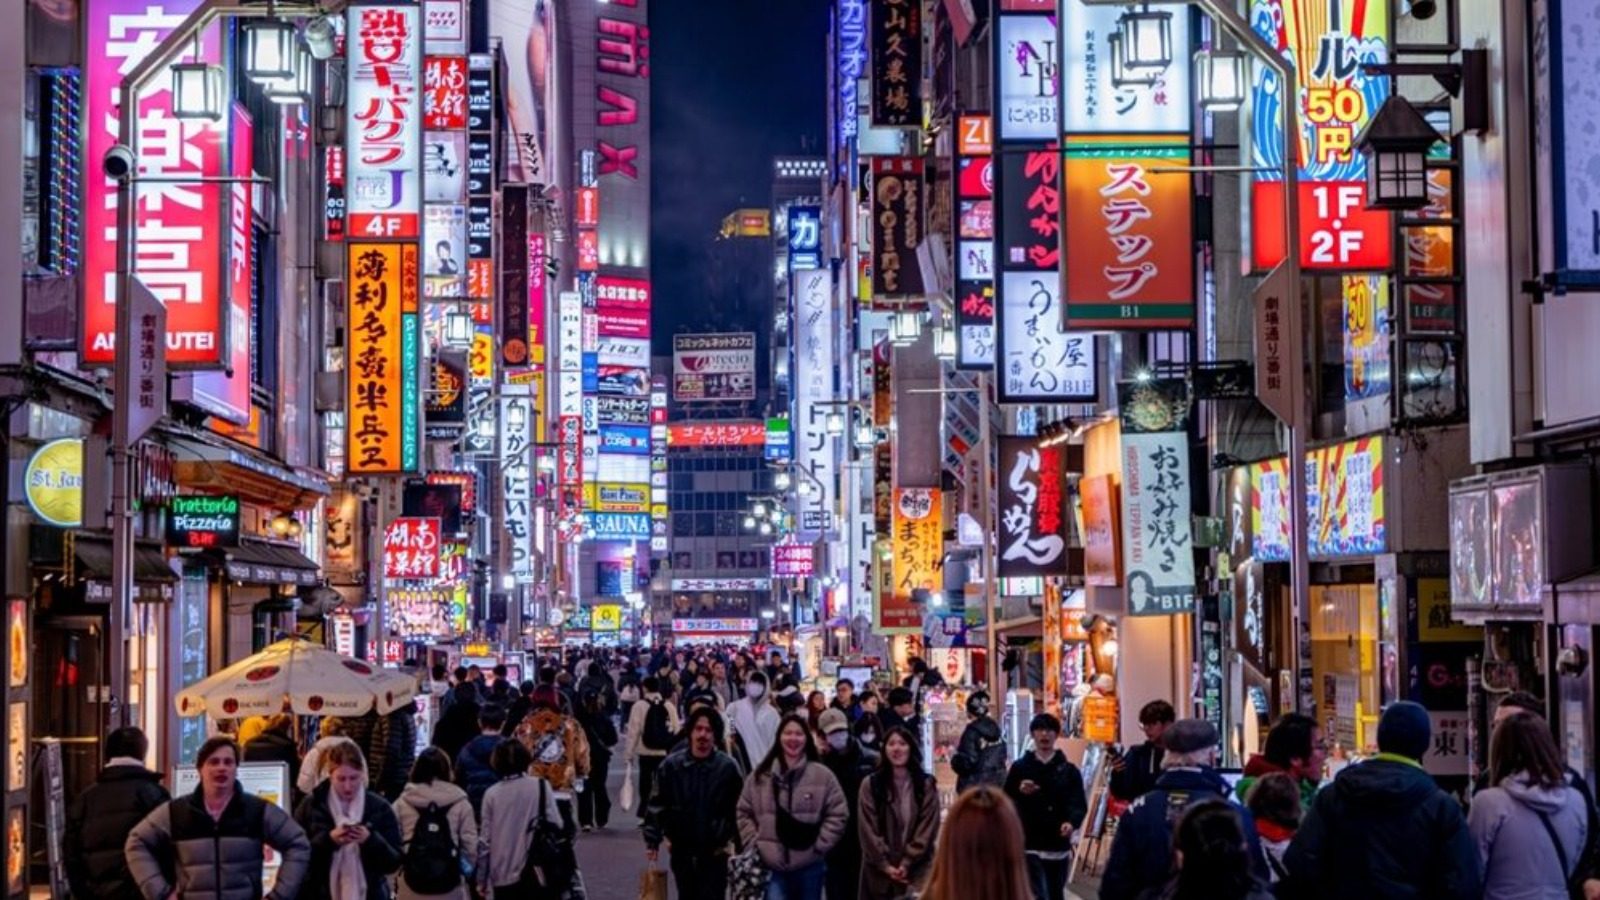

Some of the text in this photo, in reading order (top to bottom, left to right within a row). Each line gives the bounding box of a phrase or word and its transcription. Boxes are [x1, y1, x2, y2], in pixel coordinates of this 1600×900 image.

[1306, 88, 1363, 123] 50
[1317, 127, 1354, 163] 円
[1313, 187, 1363, 218] 1F
[366, 216, 402, 236] 4F
[1100, 164, 1157, 299] ステップ
[1311, 231, 1364, 262] 2F
[173, 496, 237, 513] Trattoria
[1146, 444, 1188, 573] お好み焼き
[174, 514, 232, 531] Pizzeria
[596, 514, 650, 533] SAUNA
